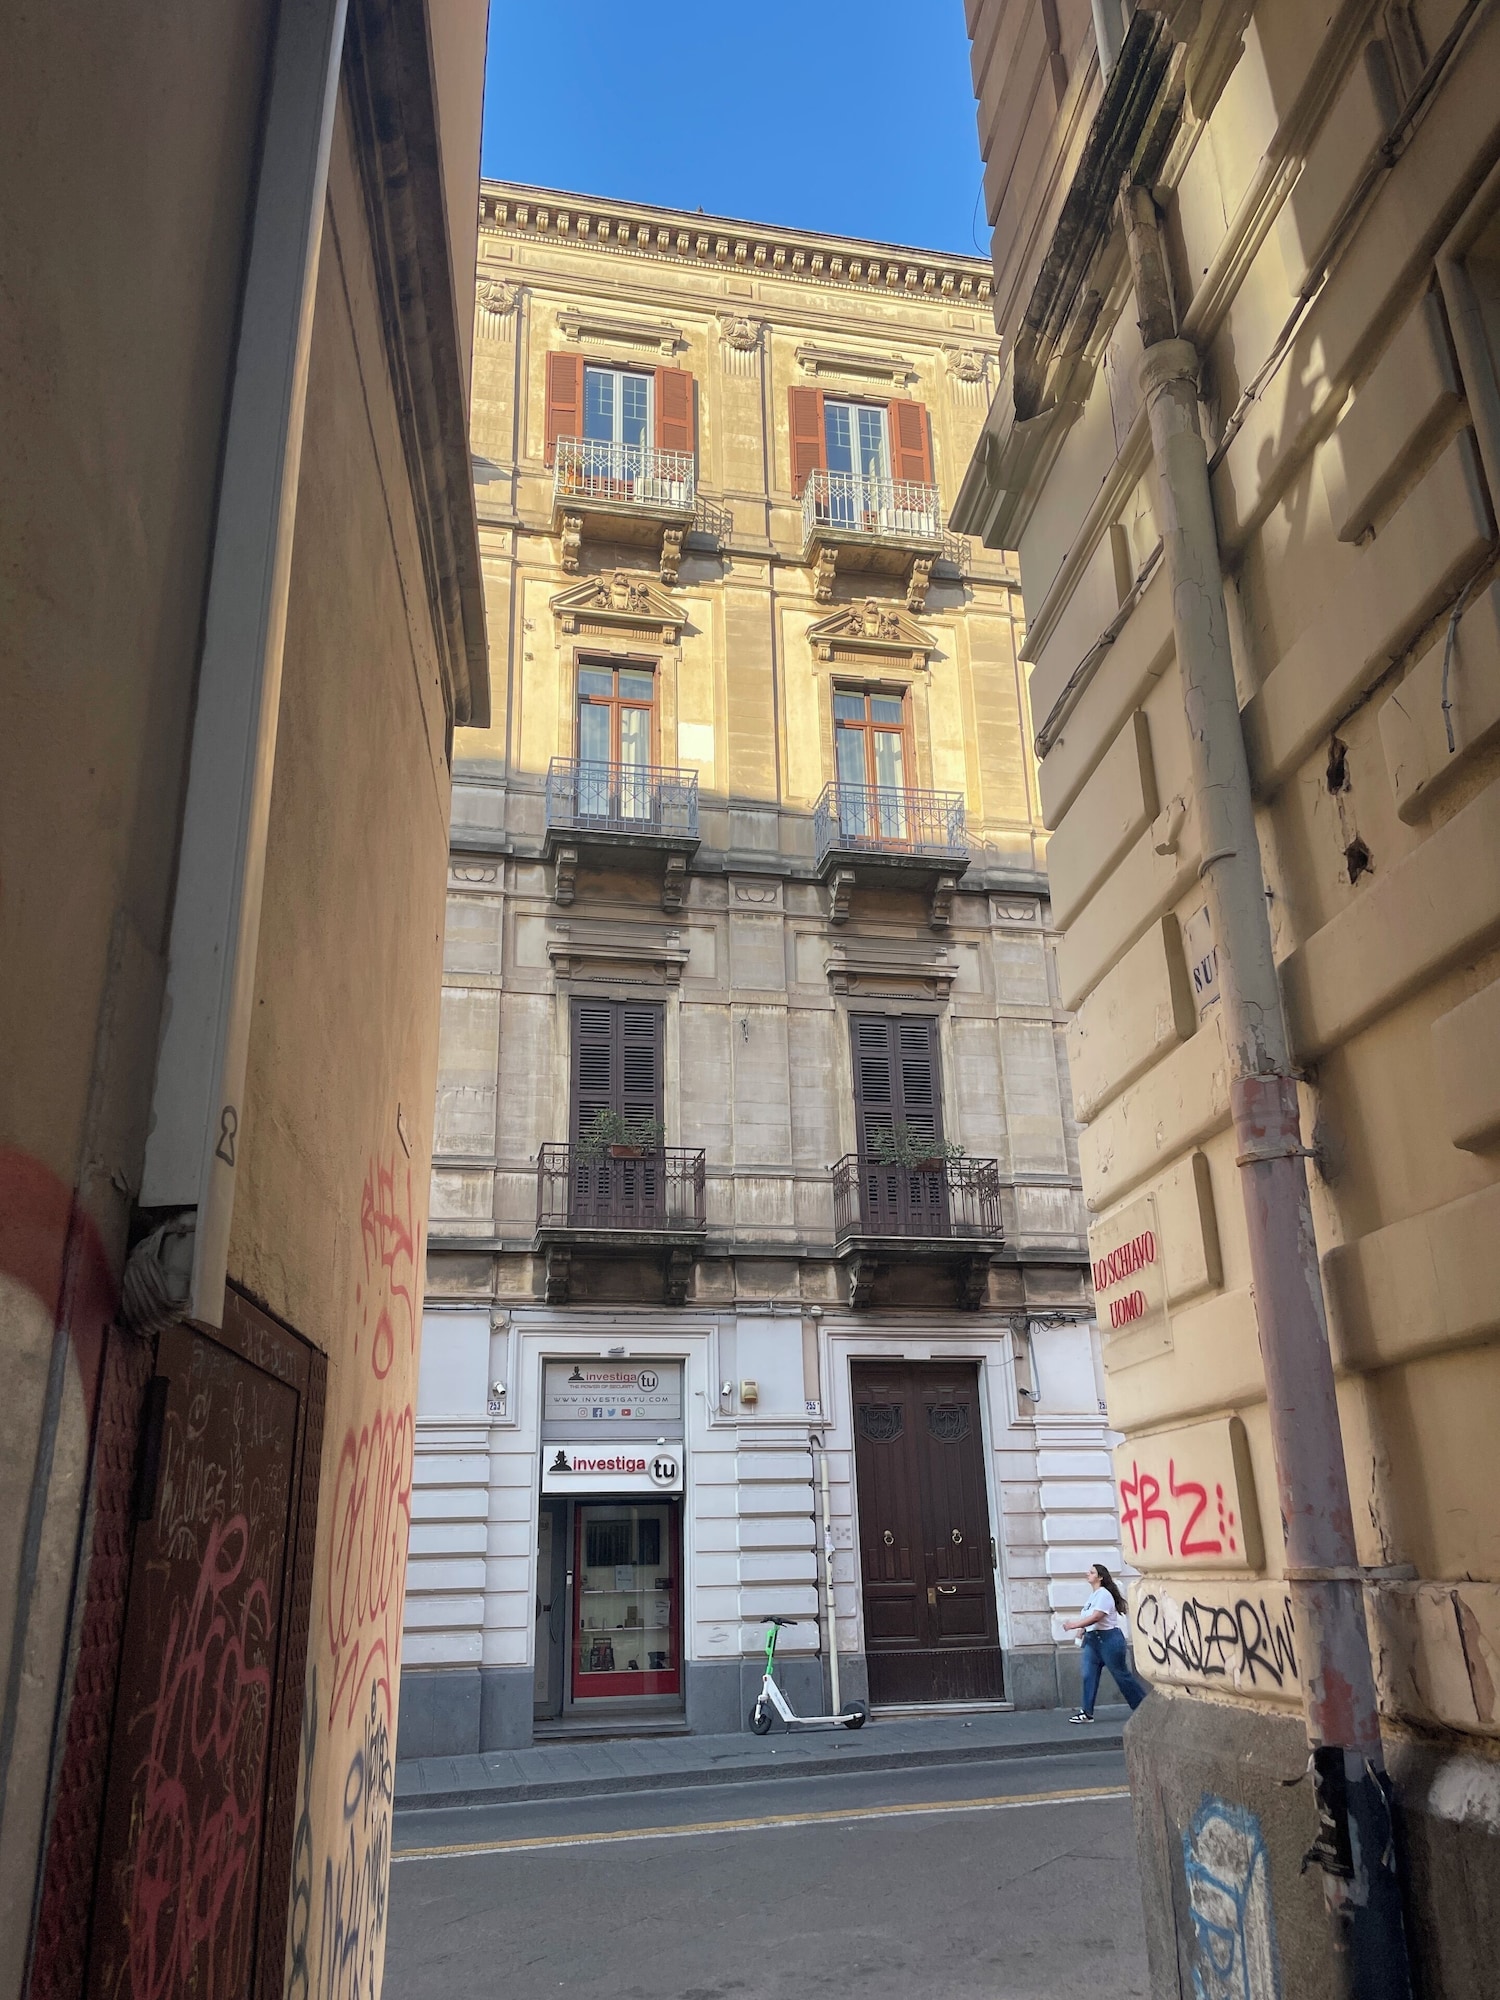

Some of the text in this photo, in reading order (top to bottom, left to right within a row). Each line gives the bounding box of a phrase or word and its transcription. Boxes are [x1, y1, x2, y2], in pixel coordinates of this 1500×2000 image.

[1093, 1230, 1155, 1292] LO SCHIAVO
[1109, 1290, 1144, 1329] UOMO
[586, 1372, 655, 1387] investiga tu
[573, 1456, 675, 1478] investiga tu
